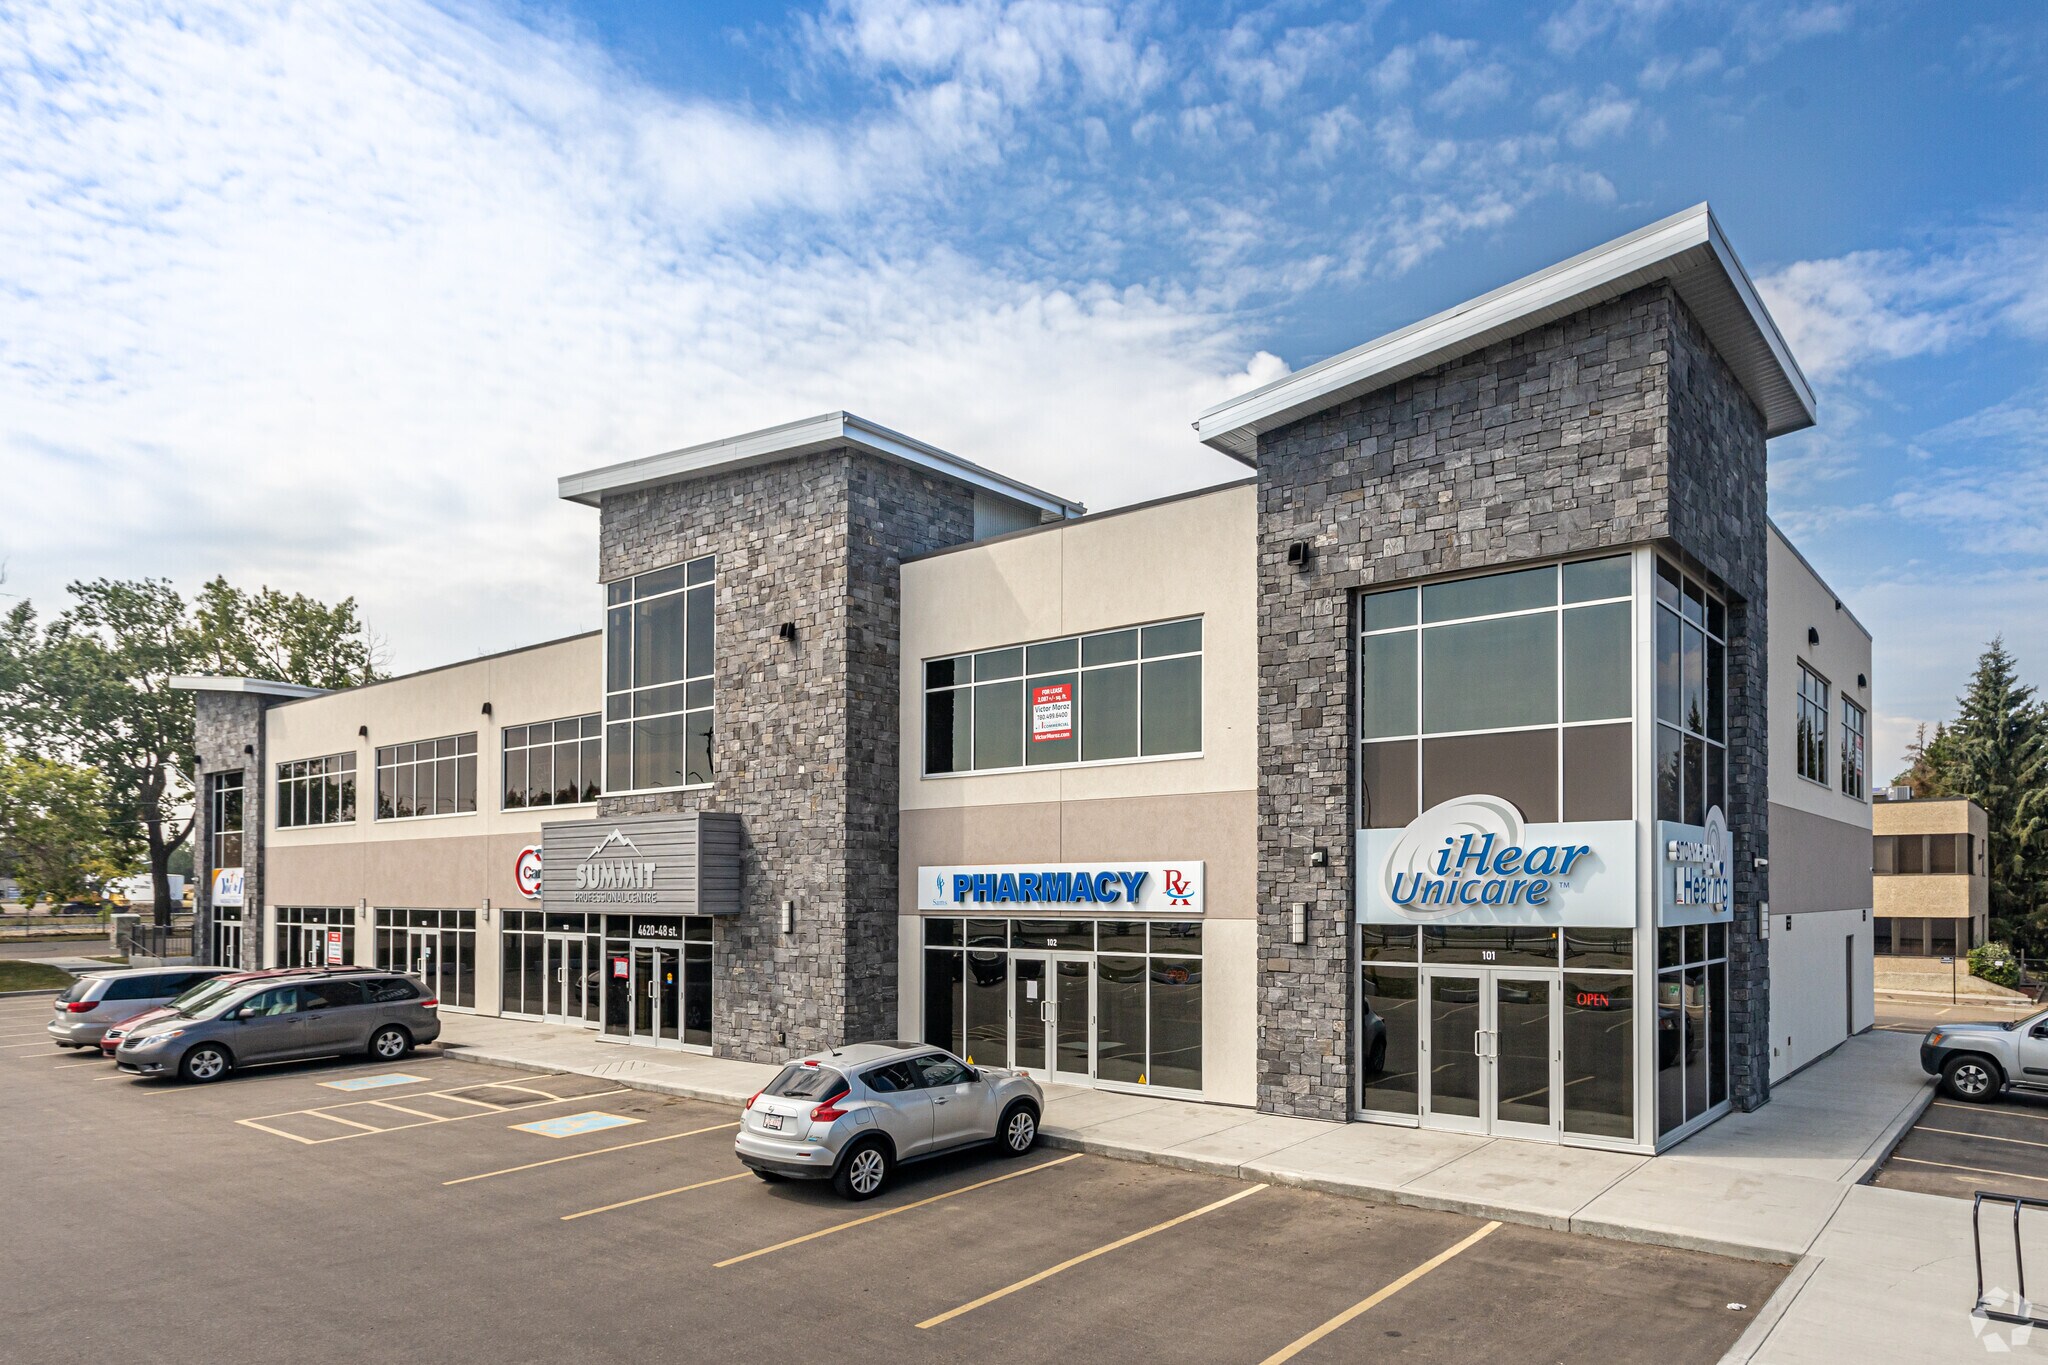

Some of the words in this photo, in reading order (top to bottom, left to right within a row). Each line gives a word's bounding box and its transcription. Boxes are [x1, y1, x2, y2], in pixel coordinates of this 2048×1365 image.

[1436, 832, 1591, 877] iHear
[575, 860, 657, 889] SUMMIT
[575, 891, 627, 903] PROFESSIONAL
[628, 891, 658, 903] CENTRE
[953, 871, 1149, 904] PHARMACY
[1391, 870, 1552, 906] Unicare
[1684, 867, 1728, 911] Hearing
[637, 925, 667, 936] 4620-48
[668, 926, 678, 937] st.
[1046, 938, 1058, 947] 102
[1482, 950, 1496, 960] 101
[1576, 992, 1610, 1007] OPEN
